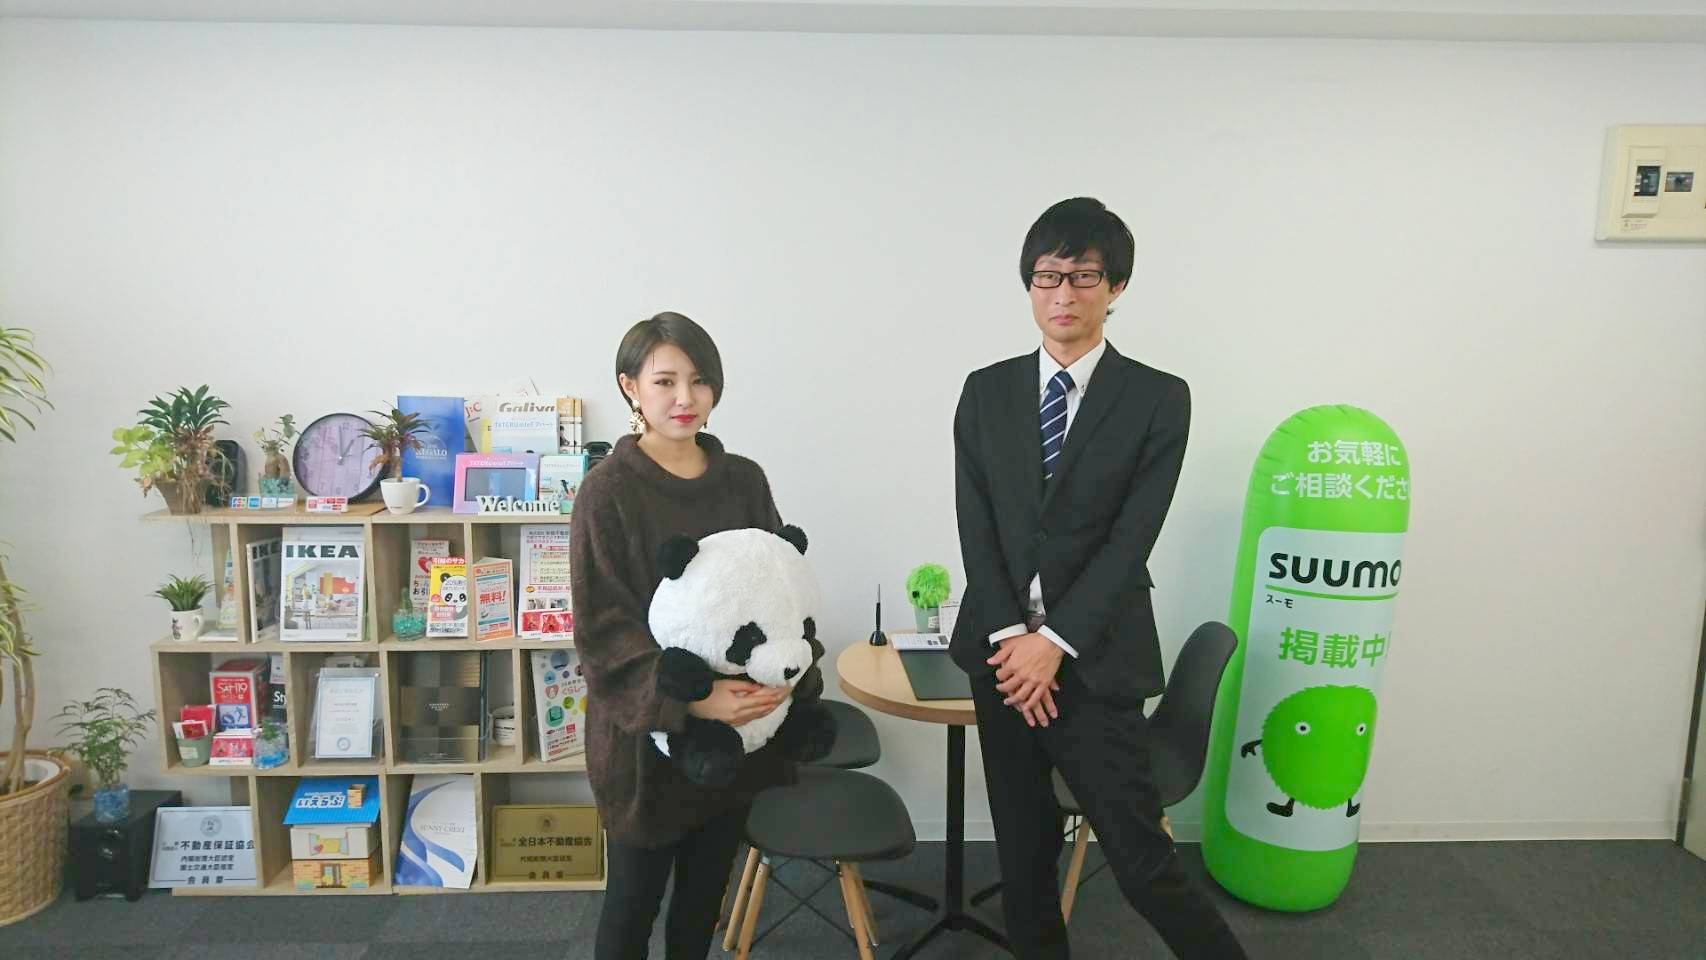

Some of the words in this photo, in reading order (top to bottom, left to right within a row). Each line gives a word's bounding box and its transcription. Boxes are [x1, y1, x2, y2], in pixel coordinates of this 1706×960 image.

[1307, 439, 1401, 466] お気軽に
[1271, 472, 1410, 500] ご相談くださ
[476, 495, 560, 512] Welcome
[286, 545, 359, 558] IKEA
[1266, 594, 1293, 609] スーモ
[180, 840, 255, 851] 不動産保証協会
